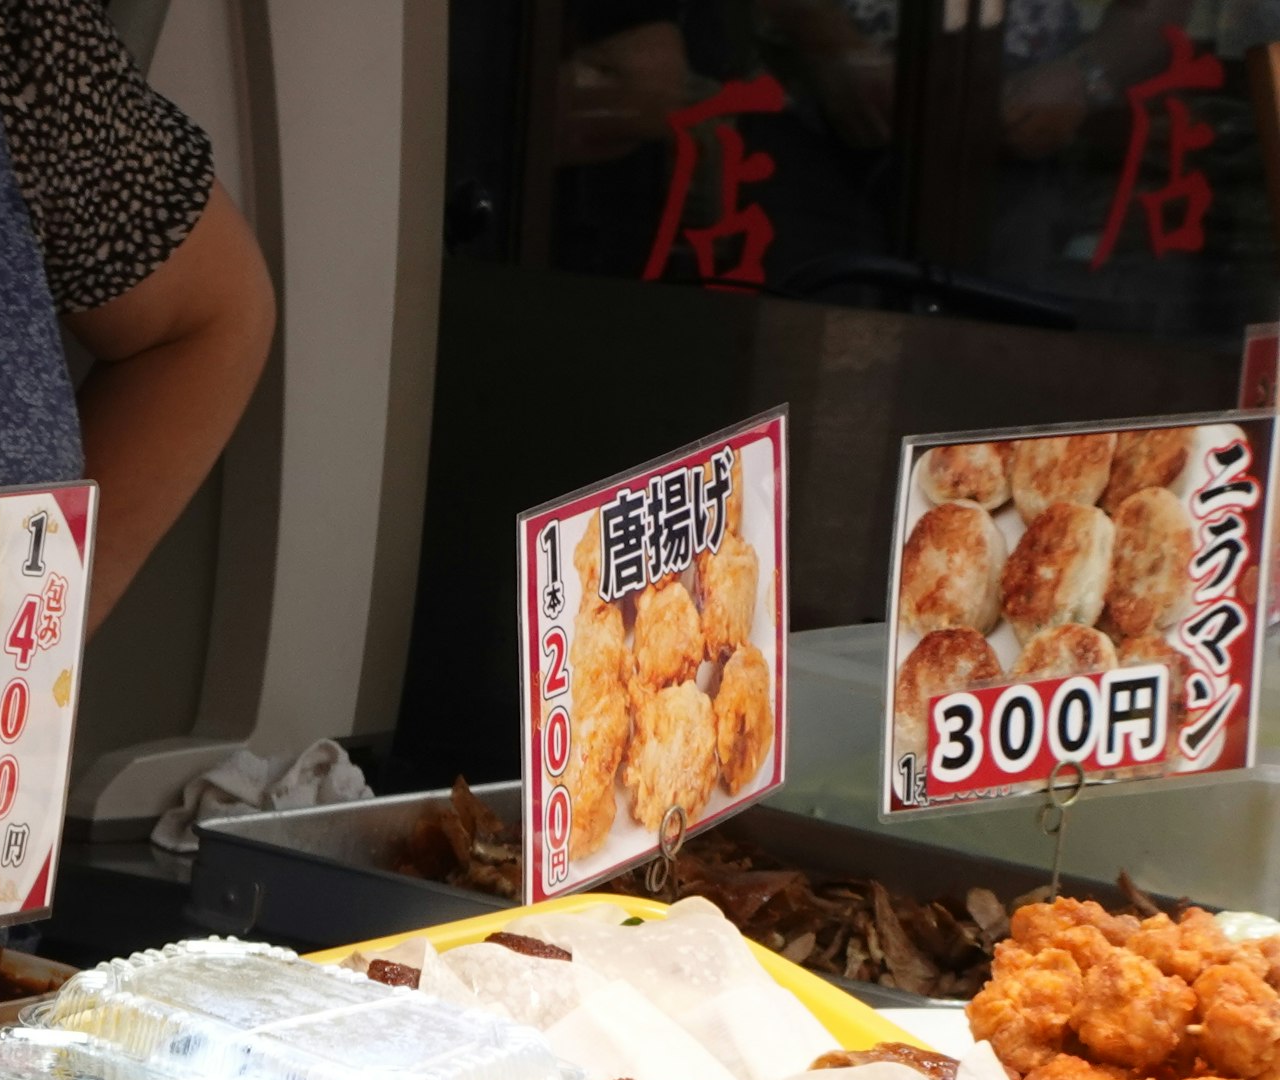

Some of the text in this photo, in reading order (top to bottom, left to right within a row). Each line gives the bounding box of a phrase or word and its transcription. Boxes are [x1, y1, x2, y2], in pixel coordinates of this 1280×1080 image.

[643, 73, 785, 293] 店
[1089, 24, 1226, 272] 店
[598, 445, 735, 603] 唐揚げ
[1181, 440, 1256, 758] ニラマン
[933, 666, 1168, 780] 300円
